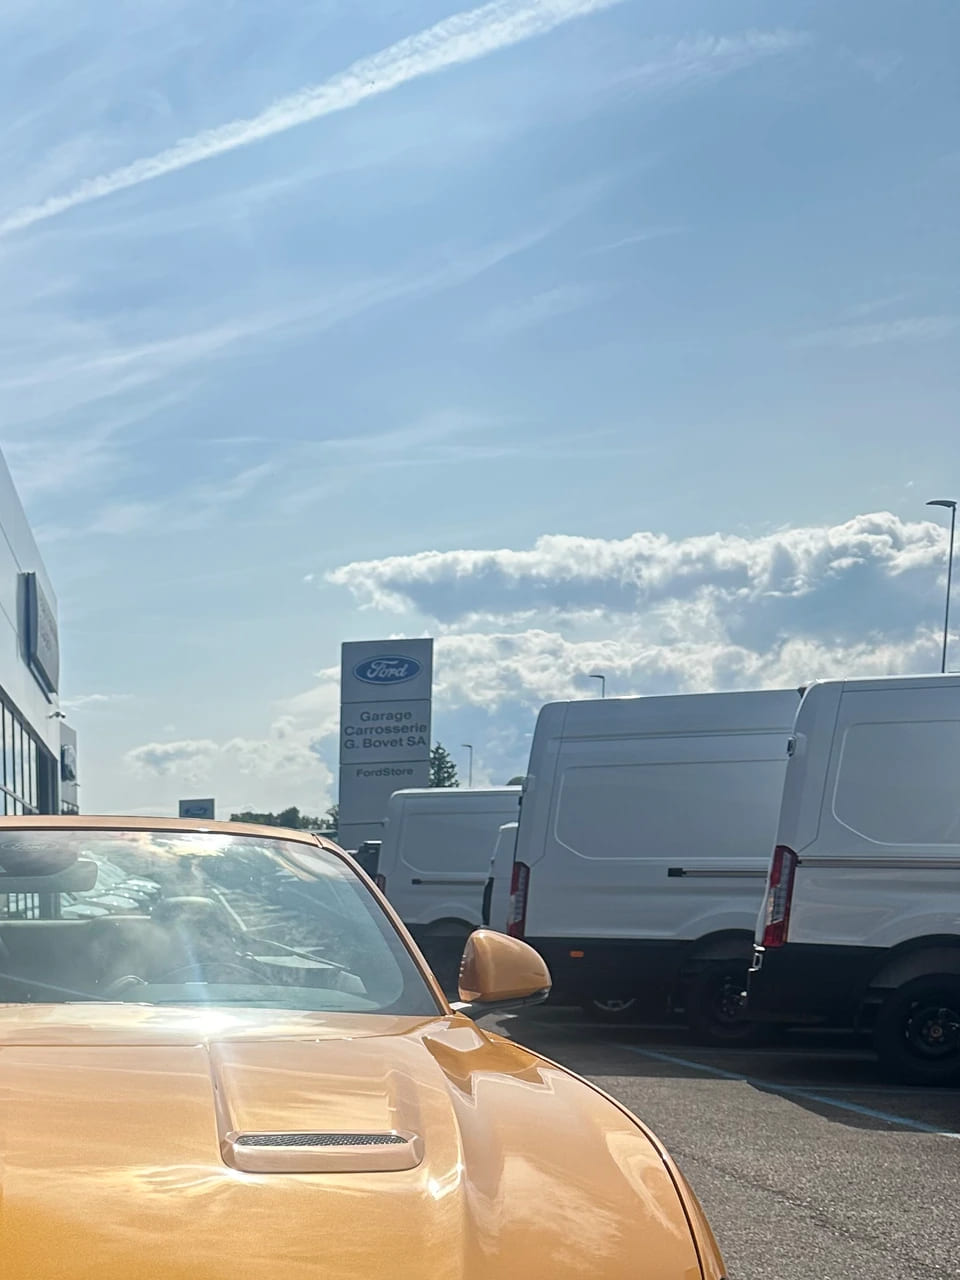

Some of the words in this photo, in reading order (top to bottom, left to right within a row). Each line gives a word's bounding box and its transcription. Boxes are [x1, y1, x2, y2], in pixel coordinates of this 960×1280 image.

[366, 660, 409, 679] Ford
[360, 711, 412, 722] Garage
[344, 723, 427, 736] Carrosserie
[344, 738, 360, 750] G.
[362, 737, 404, 749] Bovet
[407, 735, 427, 747] SA
[356, 767, 414, 778] FordStore
